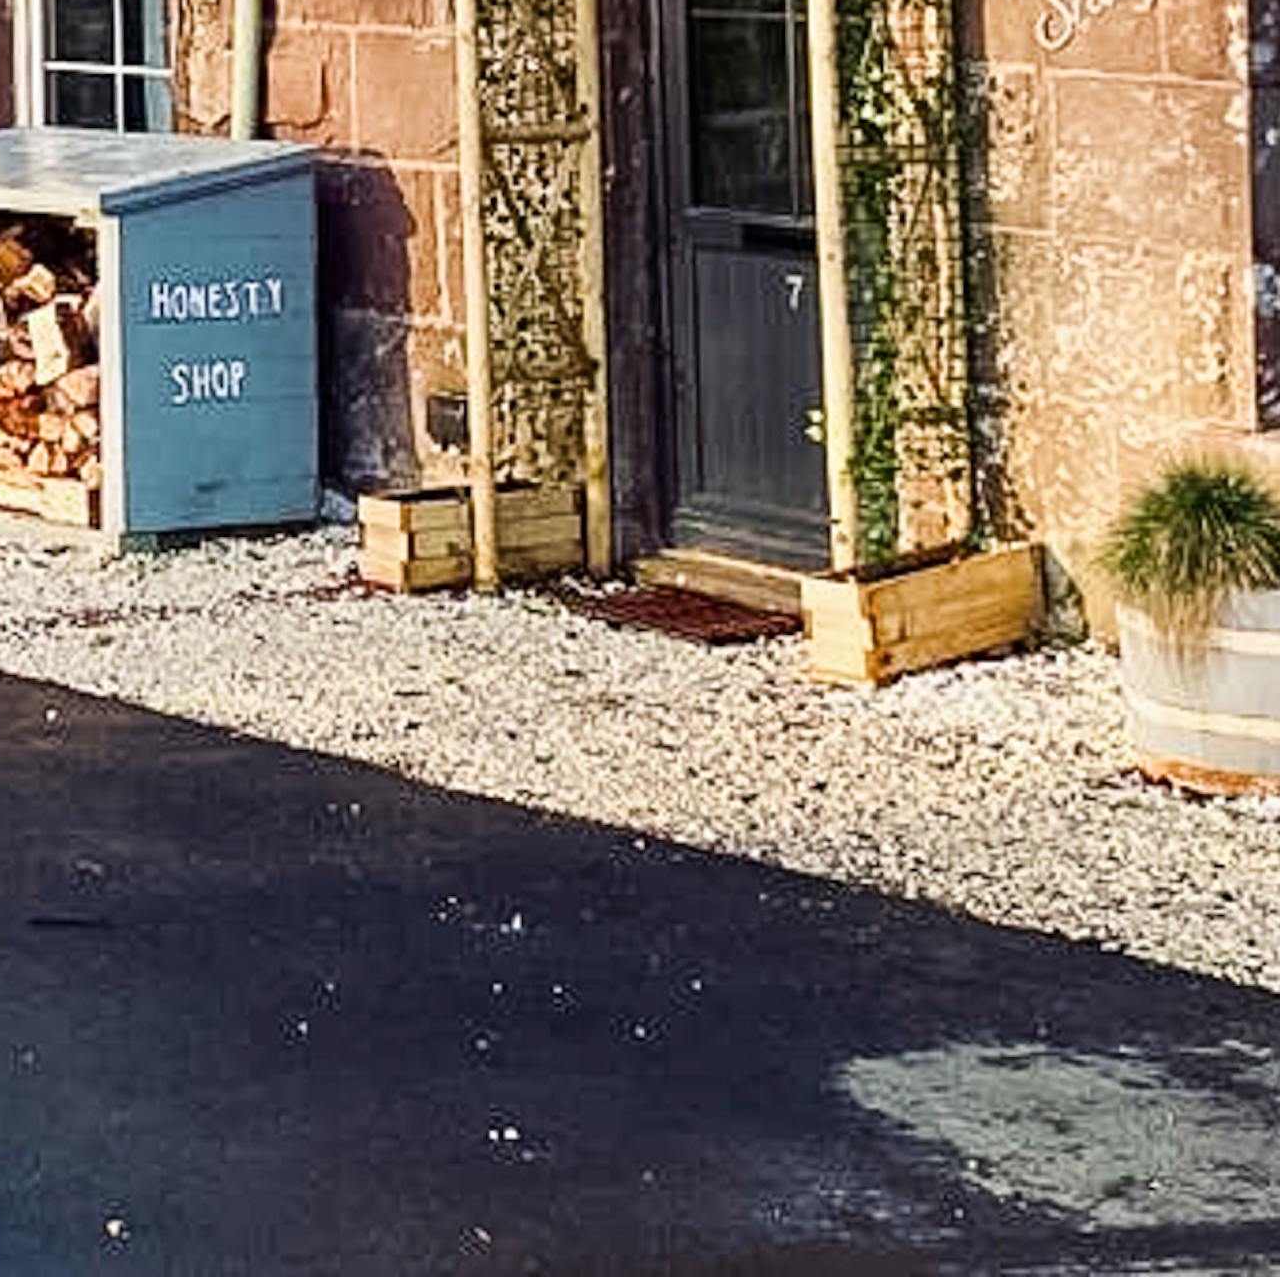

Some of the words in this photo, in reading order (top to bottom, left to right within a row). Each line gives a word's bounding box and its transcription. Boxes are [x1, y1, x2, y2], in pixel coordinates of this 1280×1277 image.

[150, 278, 283, 321] HONESTY
[785, 275, 803, 310] 7
[171, 360, 245, 406] SHOP
